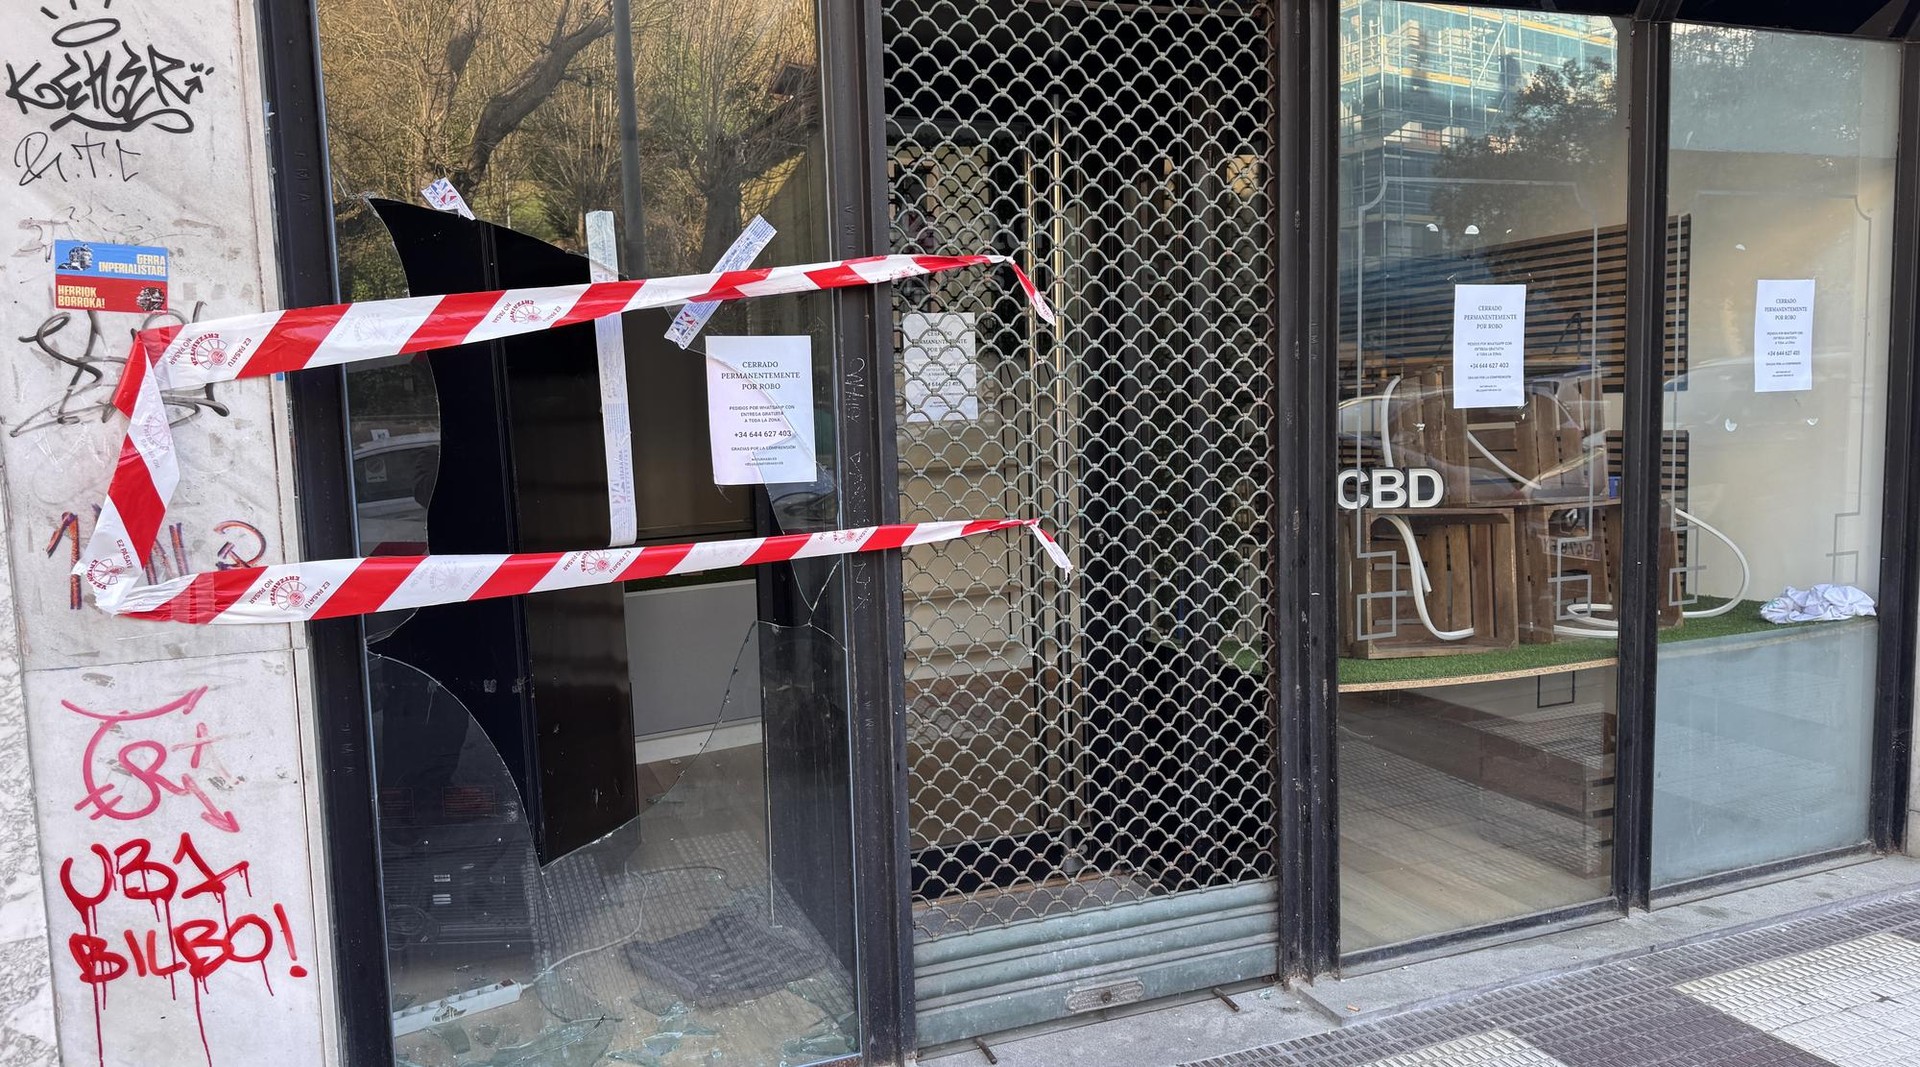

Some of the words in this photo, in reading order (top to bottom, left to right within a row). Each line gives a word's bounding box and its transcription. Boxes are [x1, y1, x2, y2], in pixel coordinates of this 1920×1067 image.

[137, 254, 165, 265] GERRA
[58, 285, 97, 297] HERRIOK
[58, 296, 105, 308] BORROKA!
[183, 337, 193, 349] NO
[244, 337, 252, 346] EZ
[168, 346, 185, 366] PASAR
[227, 344, 245, 367] PASATU
[721, 372, 801, 380] PERMANENTEMENTE
[1338, 468, 1444, 510] CBD
[265, 579, 275, 590] NO
[321, 580, 331, 590] EZ
[249, 588, 267, 605] PASAR
[304, 587, 324, 610] PASATU
[68, 903, 308, 984] BILBO!
